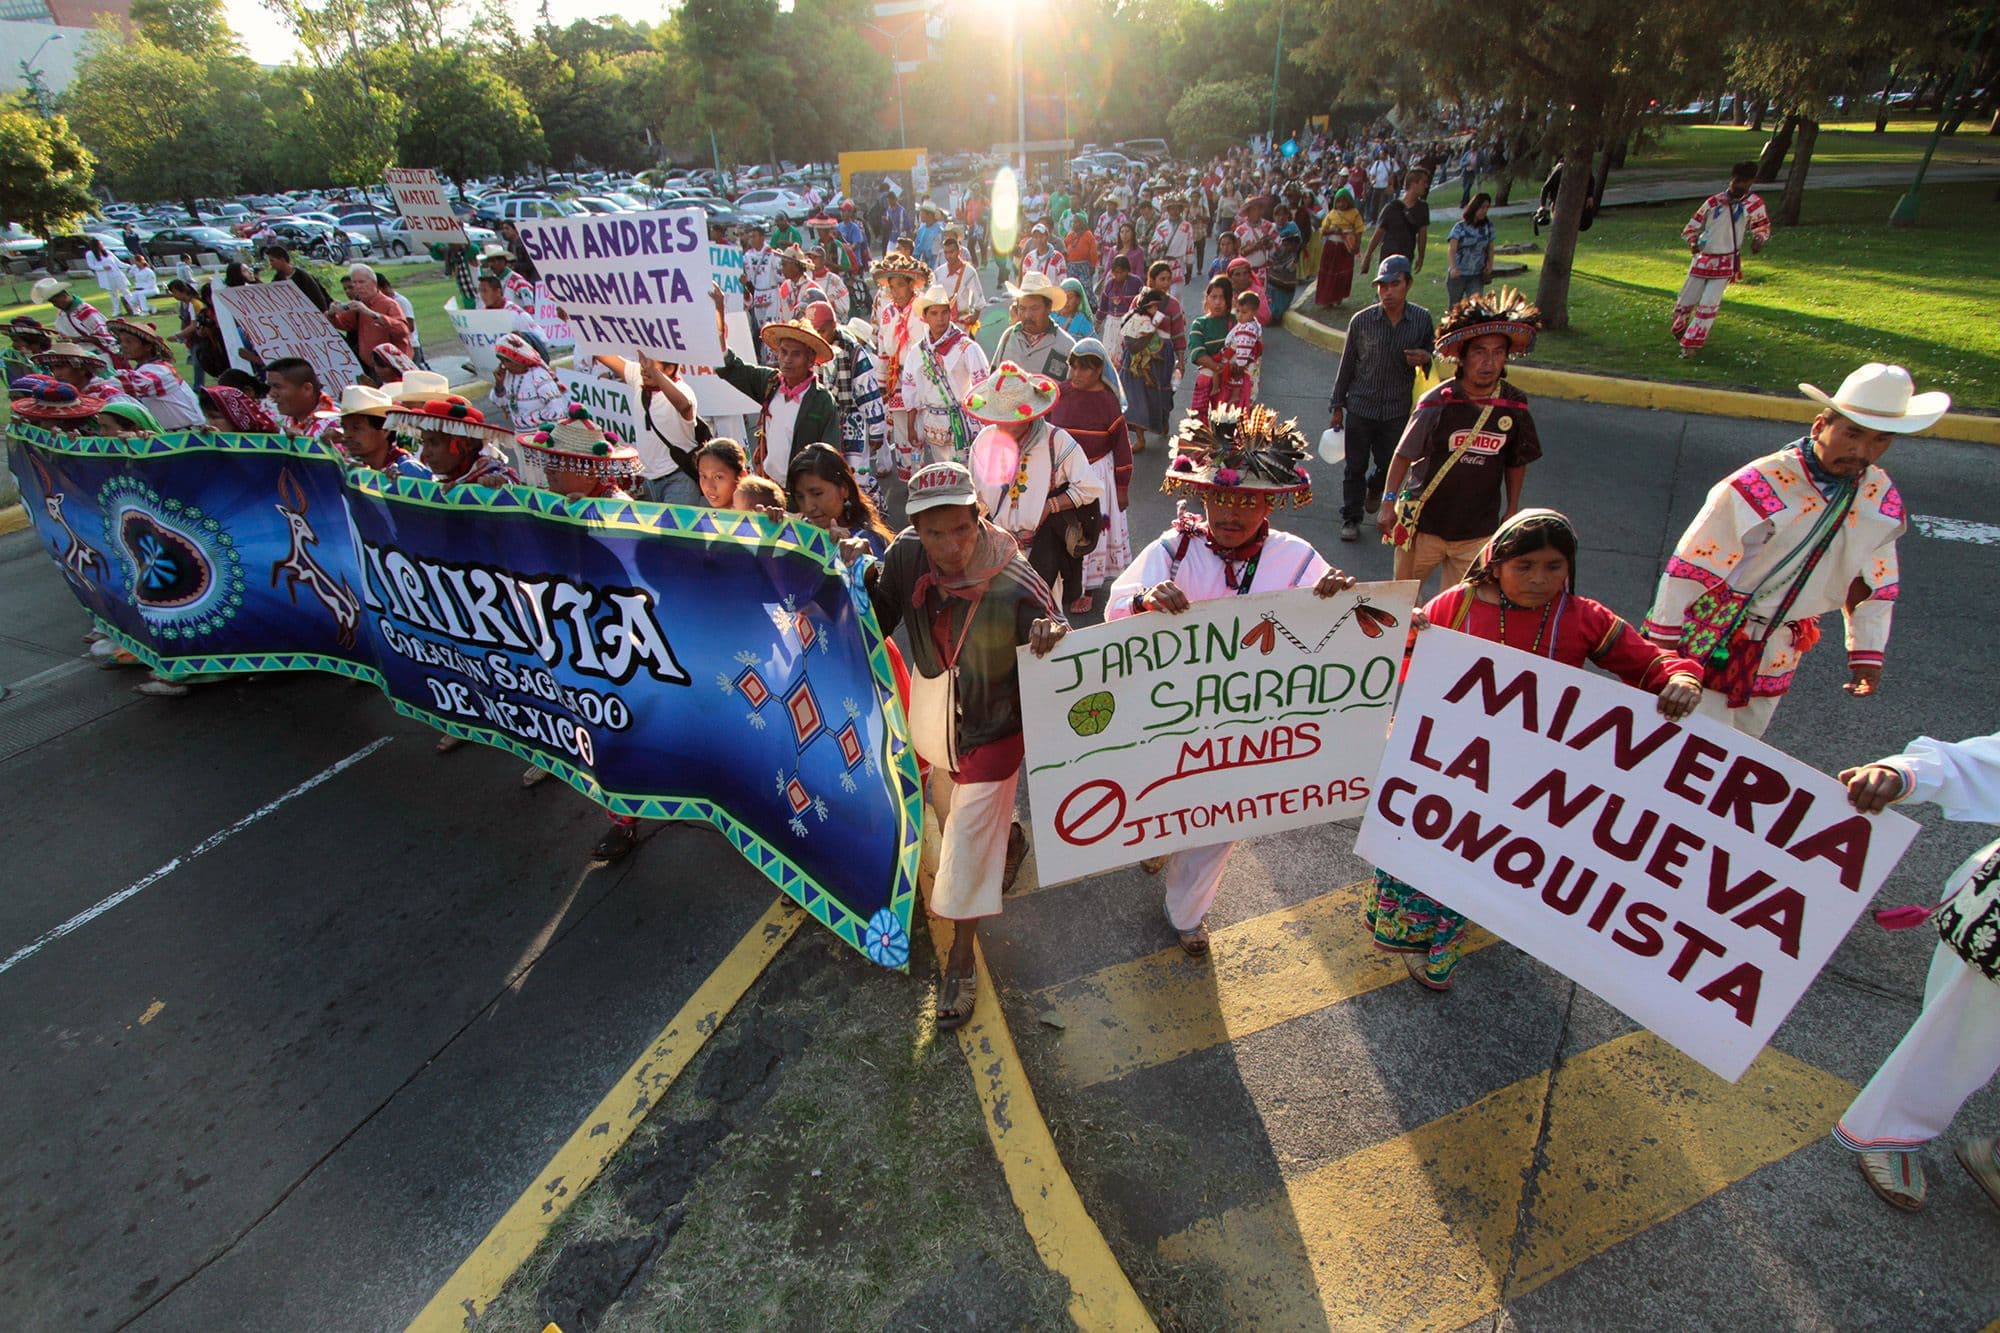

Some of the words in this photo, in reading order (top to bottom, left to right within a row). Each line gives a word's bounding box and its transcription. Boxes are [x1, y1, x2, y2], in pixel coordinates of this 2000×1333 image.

[400, 190, 440, 205] MATRIZ
[406, 215, 423, 230] DE
[424, 216, 459, 231] VIDA
[521, 226, 578, 261] SAN
[583, 216, 698, 258] ANDRES
[545, 269, 693, 305] COHAMIATA
[281, 311, 340, 341] VENDE
[540, 304, 558, 320] BOL
[570, 314, 686, 351] TATEIKIE
[570, 381, 632, 416] SANTA
[590, 415, 637, 444] RINA
[1454, 435, 1501, 450] BMBO
[918, 470, 957, 489] KISS
[1051, 616, 1240, 694] JARDIN
[427, 677, 480, 717] DE
[1143, 656, 1396, 731] SAGRADO
[1176, 722, 1322, 775] MINAS
[1443, 657, 1873, 892] MINERIA
[1122, 776, 1371, 847] JITOMATERAS
[1409, 715, 1491, 794] LA
[1512, 769, 1806, 960] NUEVA
[1377, 777, 1764, 1028] CONQUISTA
